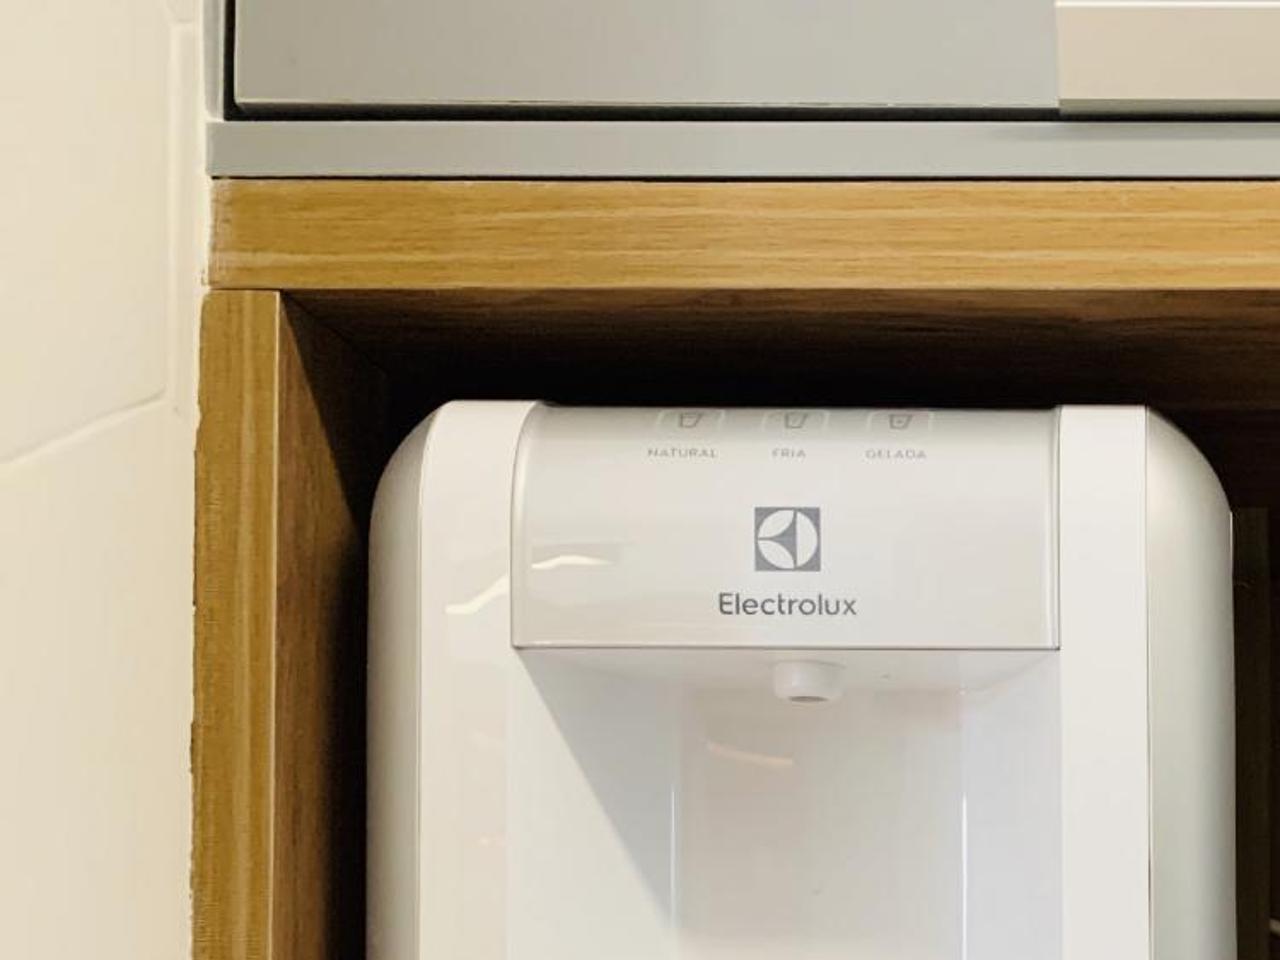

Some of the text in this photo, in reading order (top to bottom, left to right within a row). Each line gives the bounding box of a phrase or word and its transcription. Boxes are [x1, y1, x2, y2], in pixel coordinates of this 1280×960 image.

[647, 447, 719, 459] NATURAL
[771, 448, 807, 459] FRIA
[866, 449, 927, 460] GELADA
[718, 592, 857, 615] Electrolux
